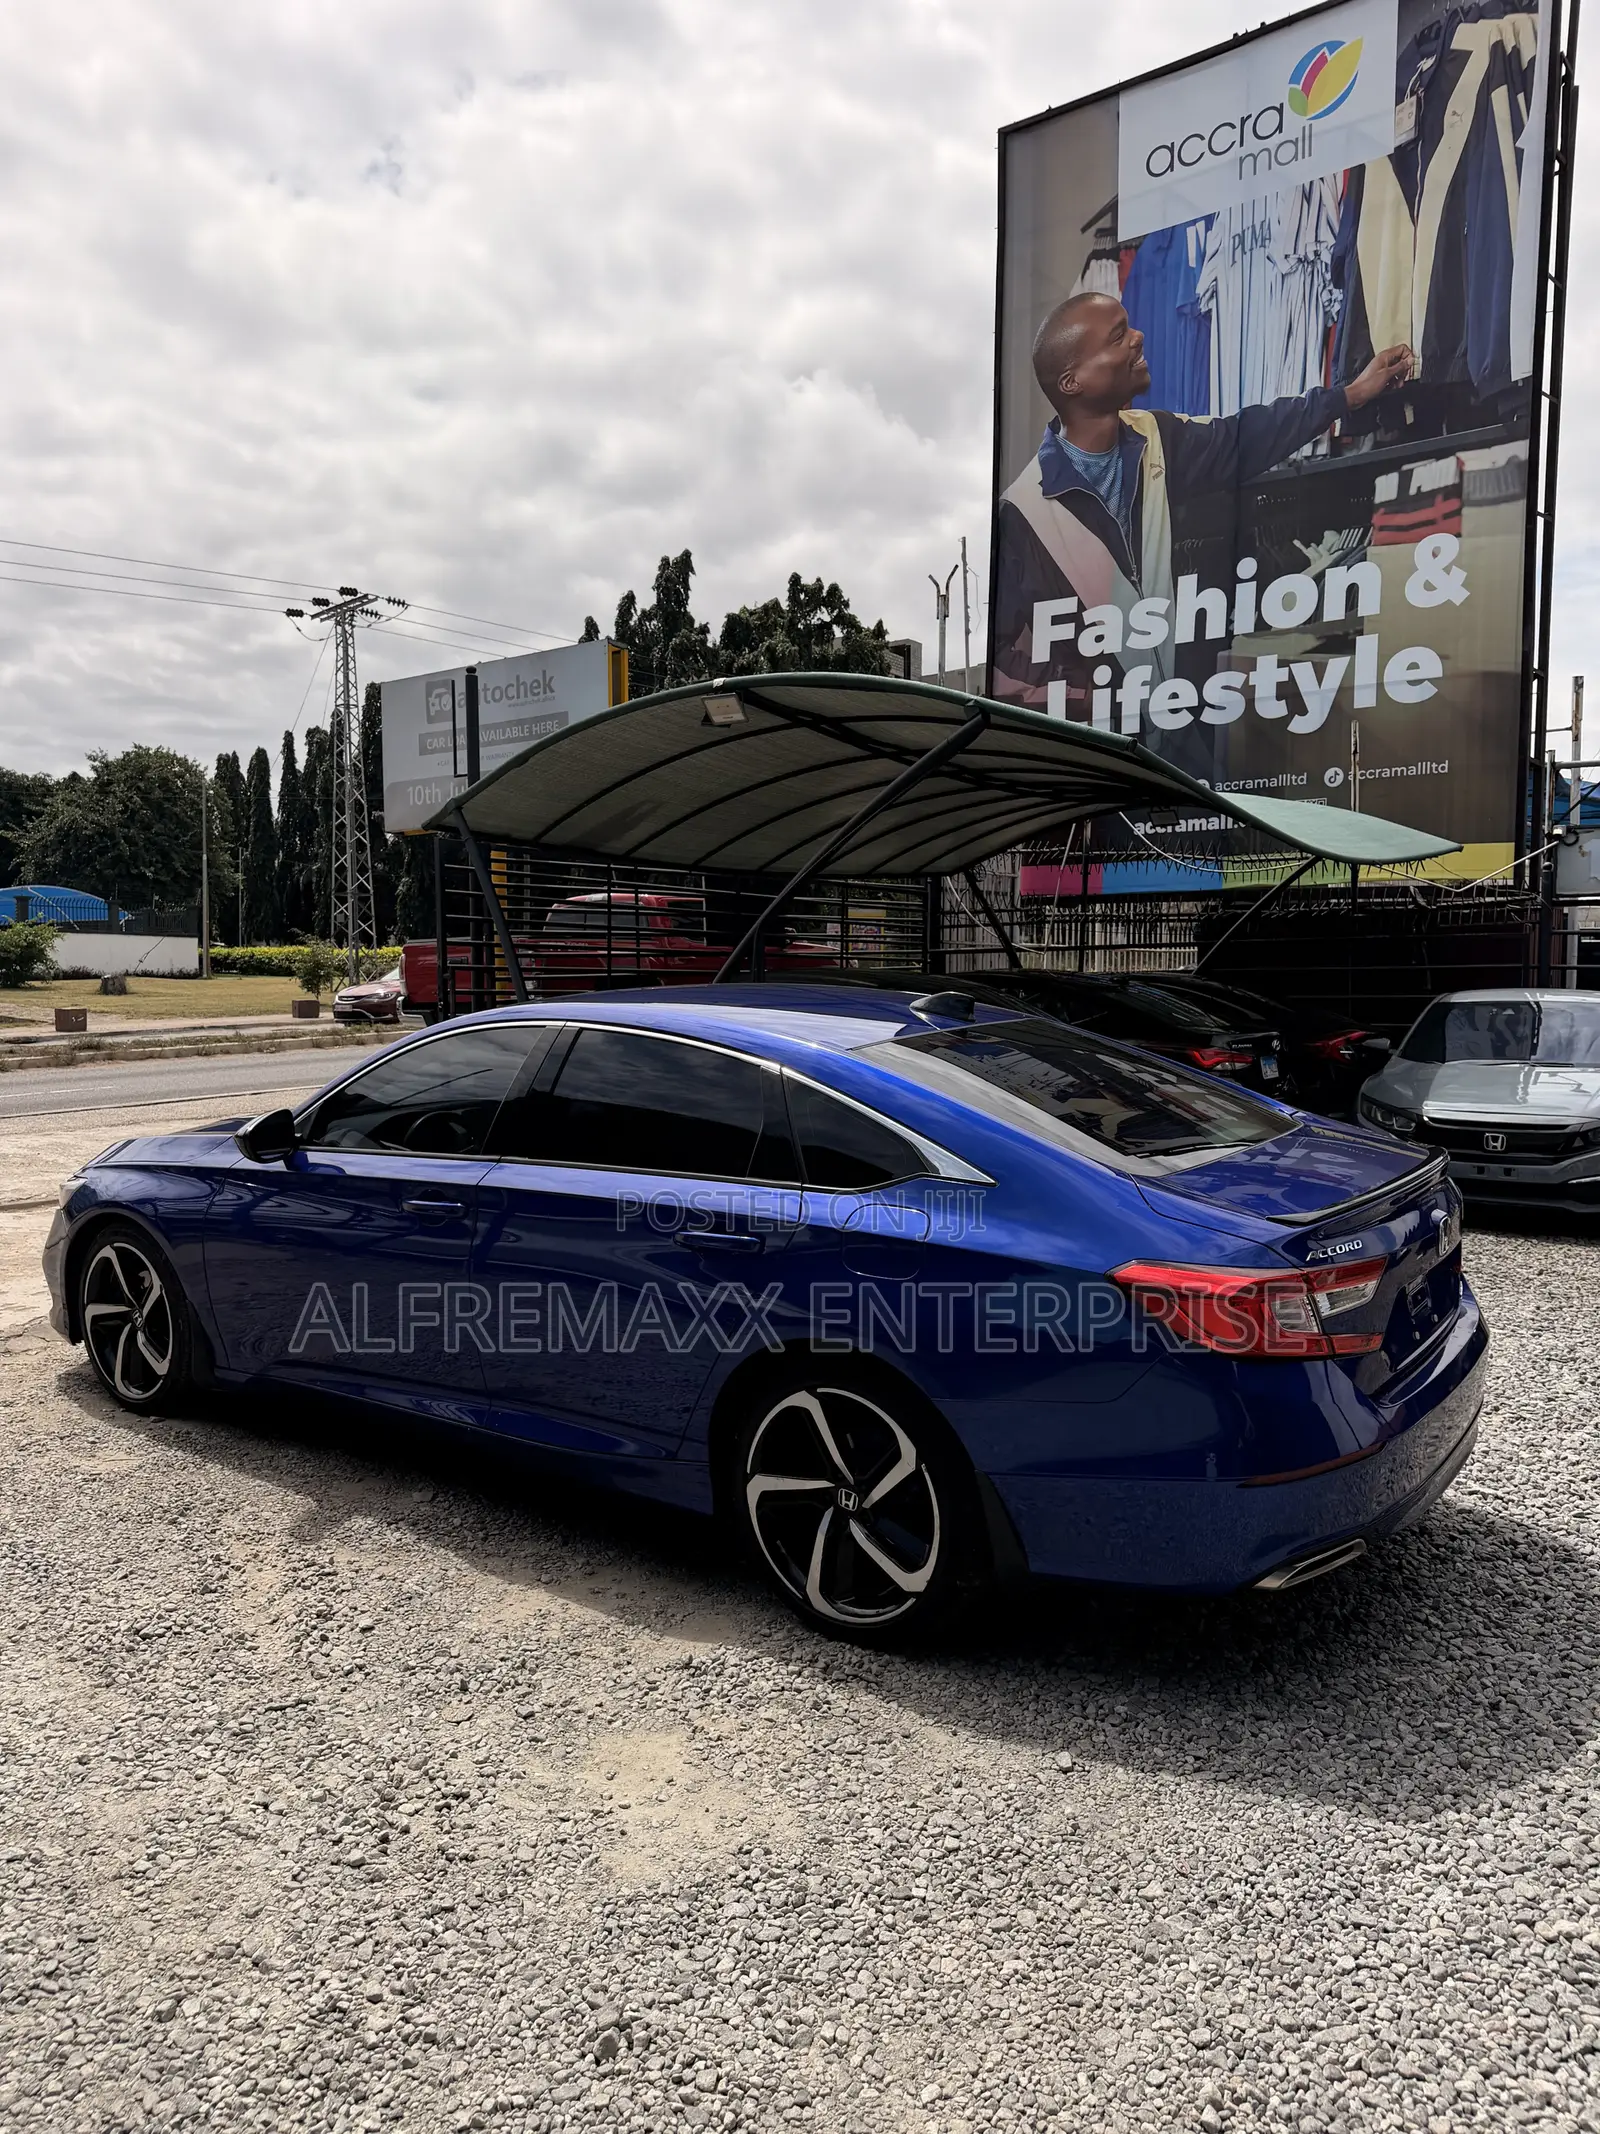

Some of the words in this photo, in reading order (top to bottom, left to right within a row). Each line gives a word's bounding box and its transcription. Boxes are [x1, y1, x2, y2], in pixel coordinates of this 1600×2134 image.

[1145, 101, 1285, 178] accra
[1238, 124, 1314, 181] mall
[1230, 218, 1271, 267] PUMA
[1031, 556, 1383, 664] Fashion
[1404, 532, 1471, 608] &
[457, 669, 555, 709] atochek
[1047, 633, 1444, 734] Lifestyle
[426, 737, 446, 750] CAR
[447, 733, 466, 747] LA
[480, 725, 529, 742] AVAILABLE
[532, 719, 560, 735] HERE
[406, 781, 442, 807] 10th
[1214, 772, 1308, 792] accramallltd
[1133, 813, 1247, 836] acamall.
[1305, 1239, 1363, 1262] ACCORD
